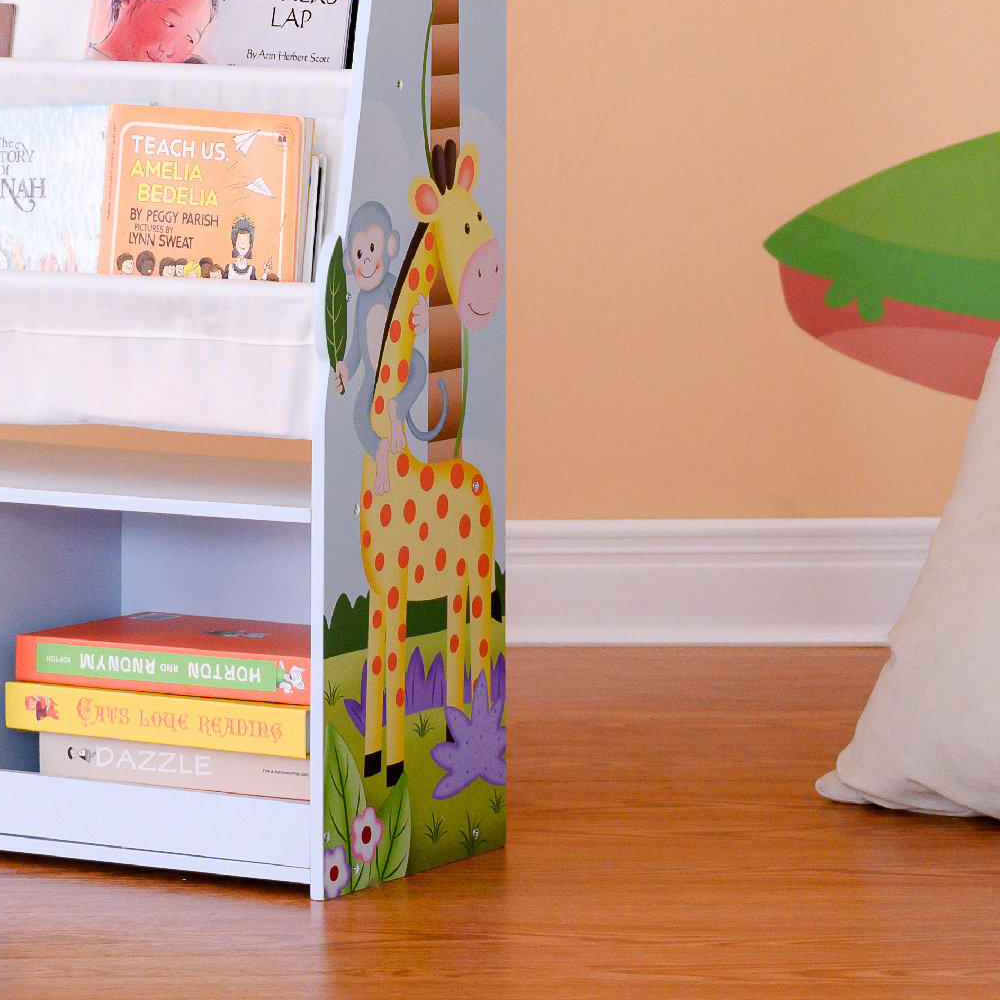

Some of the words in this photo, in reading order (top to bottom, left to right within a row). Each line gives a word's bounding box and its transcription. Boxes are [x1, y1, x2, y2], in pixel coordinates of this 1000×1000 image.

[271, 6, 312, 29] LAP
[246, 49, 258, 60] By
[257, 49, 276, 60] Ann
[278, 51, 308, 62] Herbert
[309, 53, 330, 63] Scott
[130, 133, 195, 159] TEACH
[130, 159, 203, 183] AMELIA
[137, 183, 219, 209] BEDELIA
[129, 207, 143, 221] BY
[146, 209, 179, 224] PEGGY
[182, 211, 219, 228] PARISH
[134, 222, 164, 234] PICTURES
[165, 225, 174, 234] BY
[128, 231, 156, 247] LYNN
[158, 234, 194, 250] SWEAT
[79, 653, 156, 675] ANONYM
[188, 661, 261, 683] HORTON
[95, 746, 213, 777] DAZZLE
